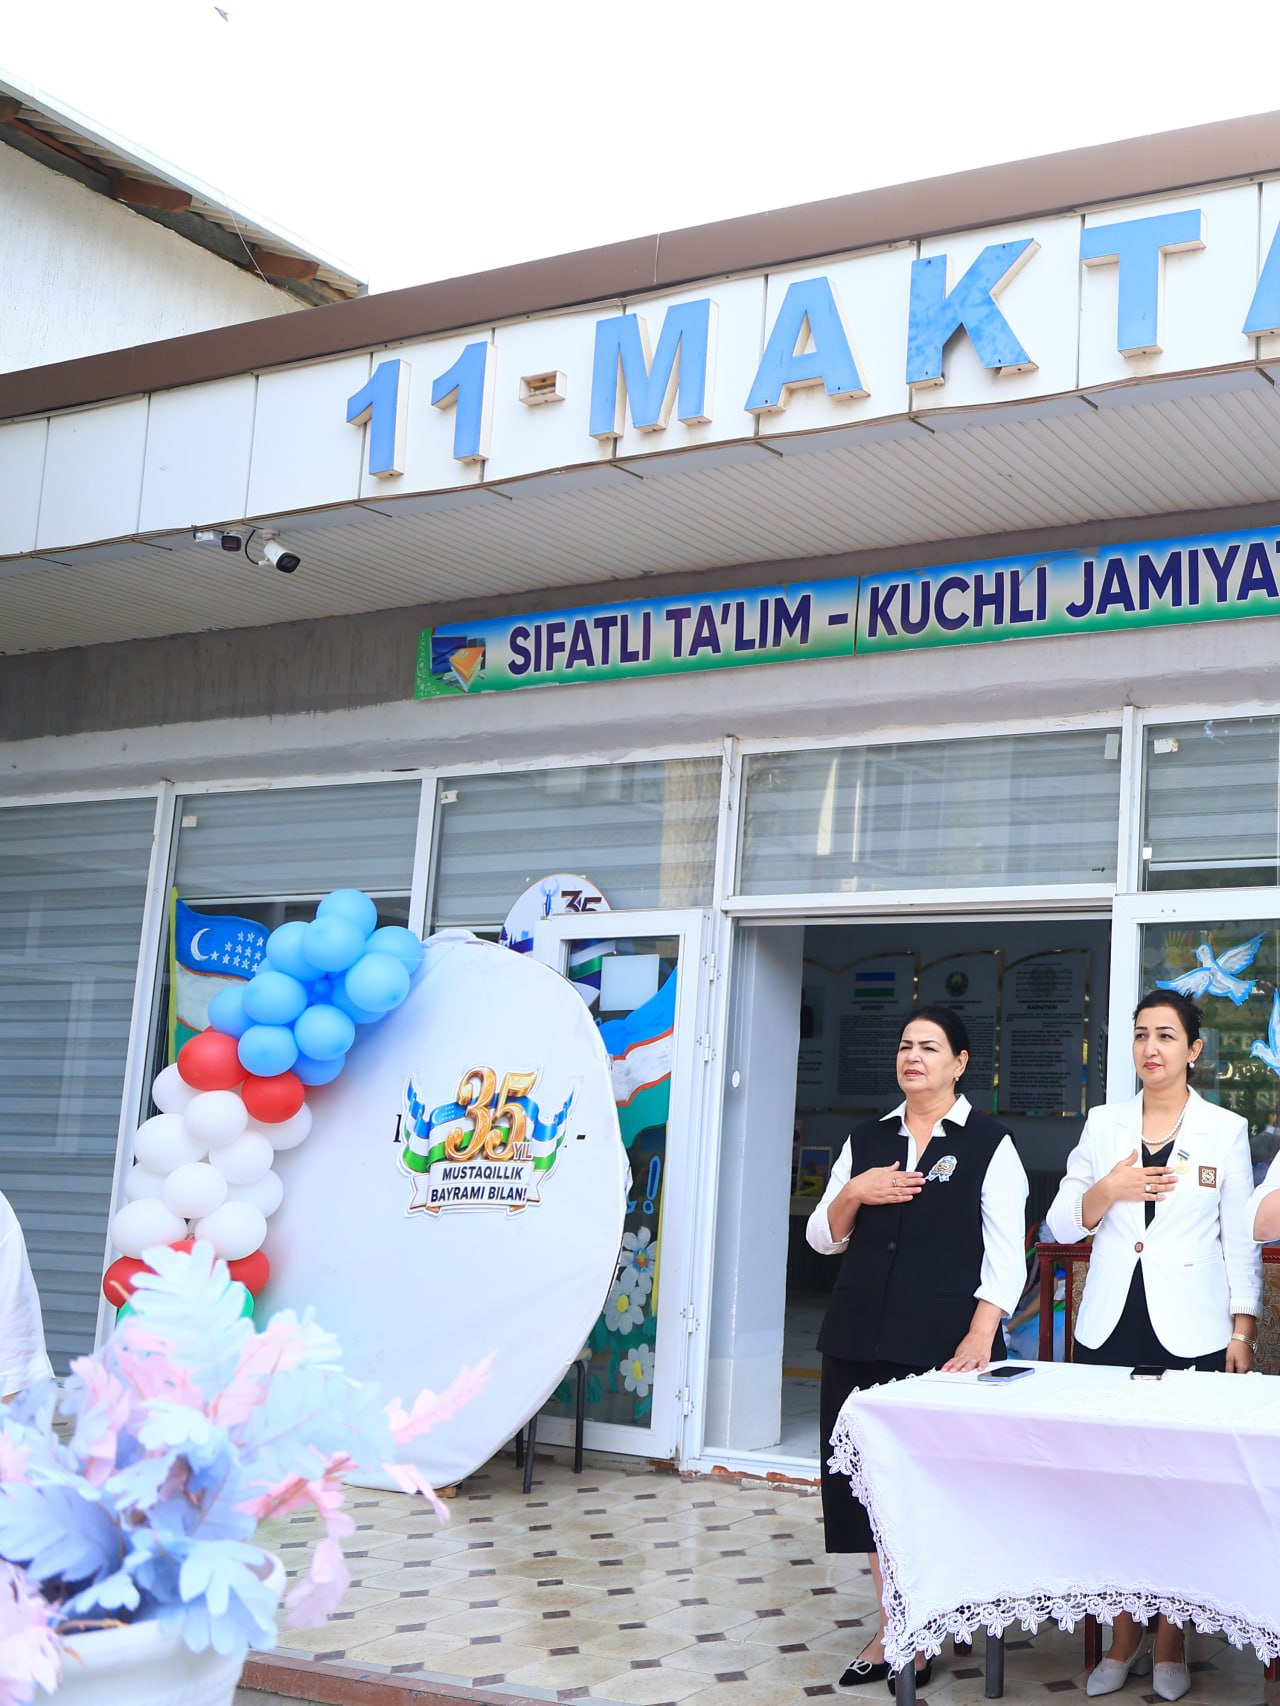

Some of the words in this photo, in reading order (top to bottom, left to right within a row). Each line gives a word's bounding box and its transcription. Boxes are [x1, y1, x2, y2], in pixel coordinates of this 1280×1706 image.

[507, 610, 652, 677] SIFATLI
[665, 593, 812, 659] TA'LIM
[866, 566, 1048, 639] KUCHLI
[444, 1065, 538, 1162] 35
[511, 1141, 533, 1160] YIL
[441, 1165, 525, 1182] MUSTAQILLIK
[430, 1185, 485, 1203] BAYRAMI
[487, 1184, 528, 1202] BILAN!
